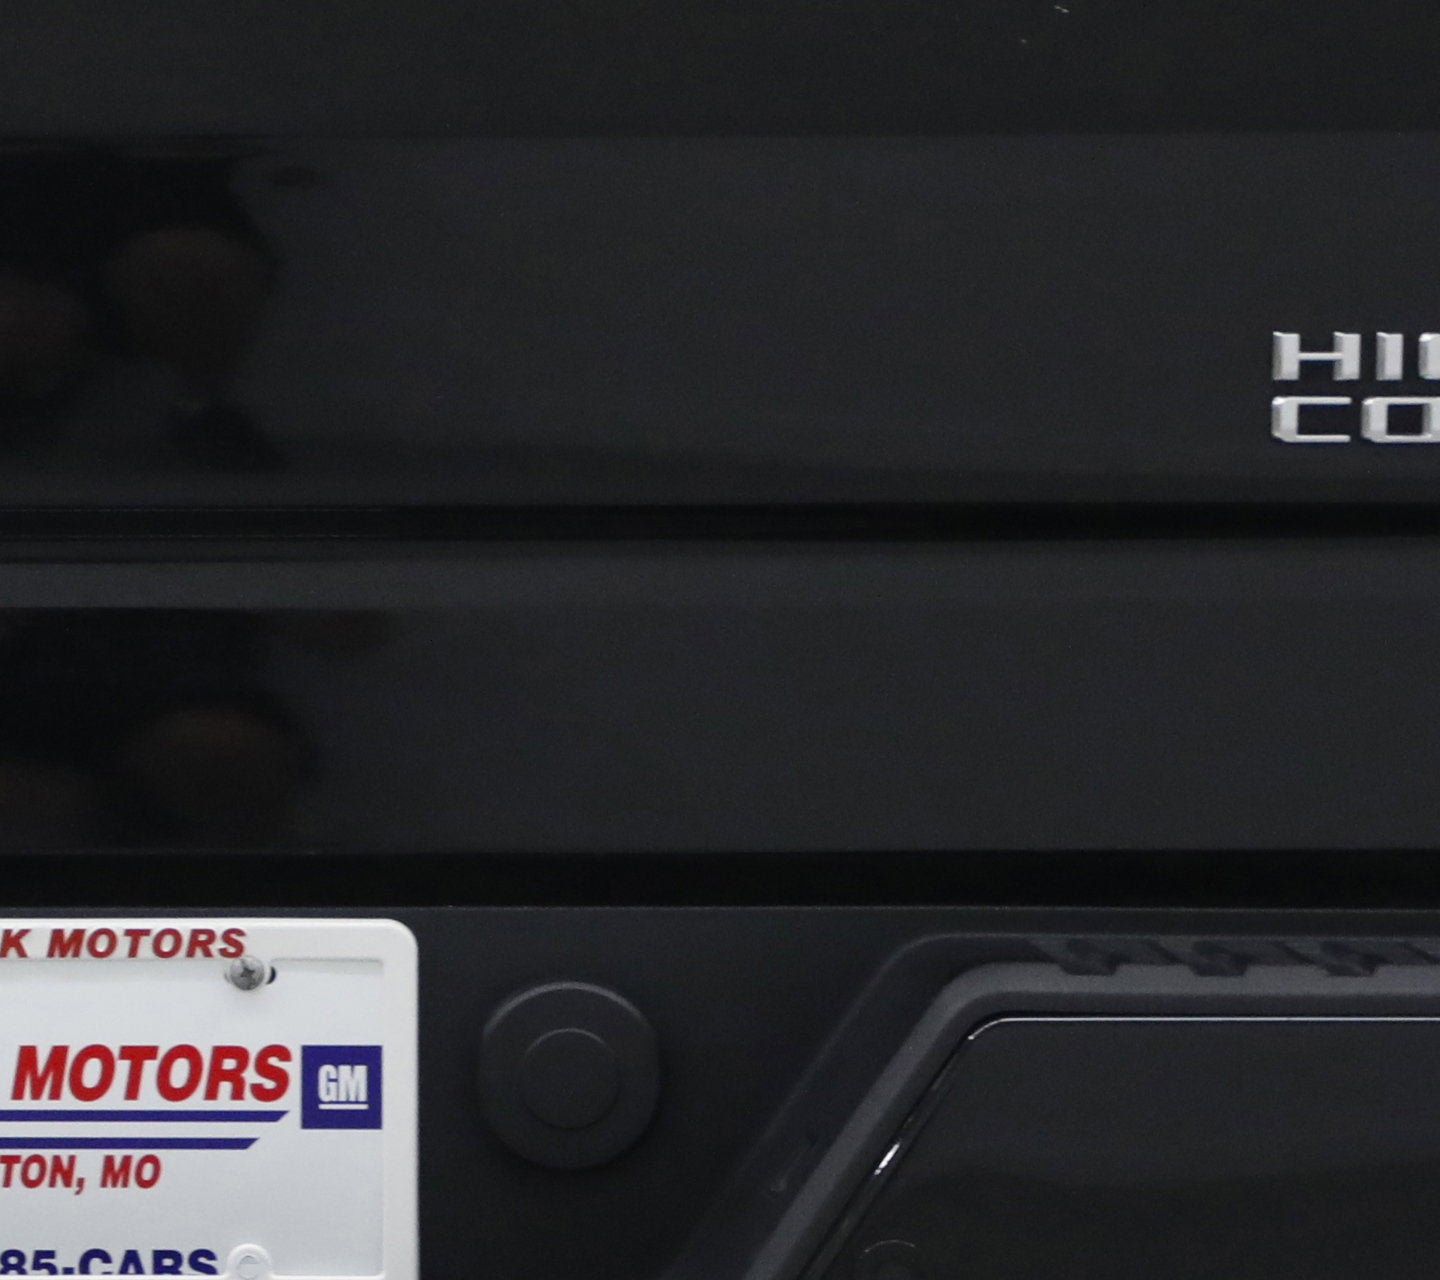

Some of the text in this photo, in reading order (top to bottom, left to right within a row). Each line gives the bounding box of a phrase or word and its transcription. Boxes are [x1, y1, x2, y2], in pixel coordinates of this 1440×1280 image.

[46, 927, 247, 959] MOTORS
[11, 1043, 291, 1101] MOTORS
[317, 1063, 369, 1105] GM
[100, 1154, 162, 1189] MO
